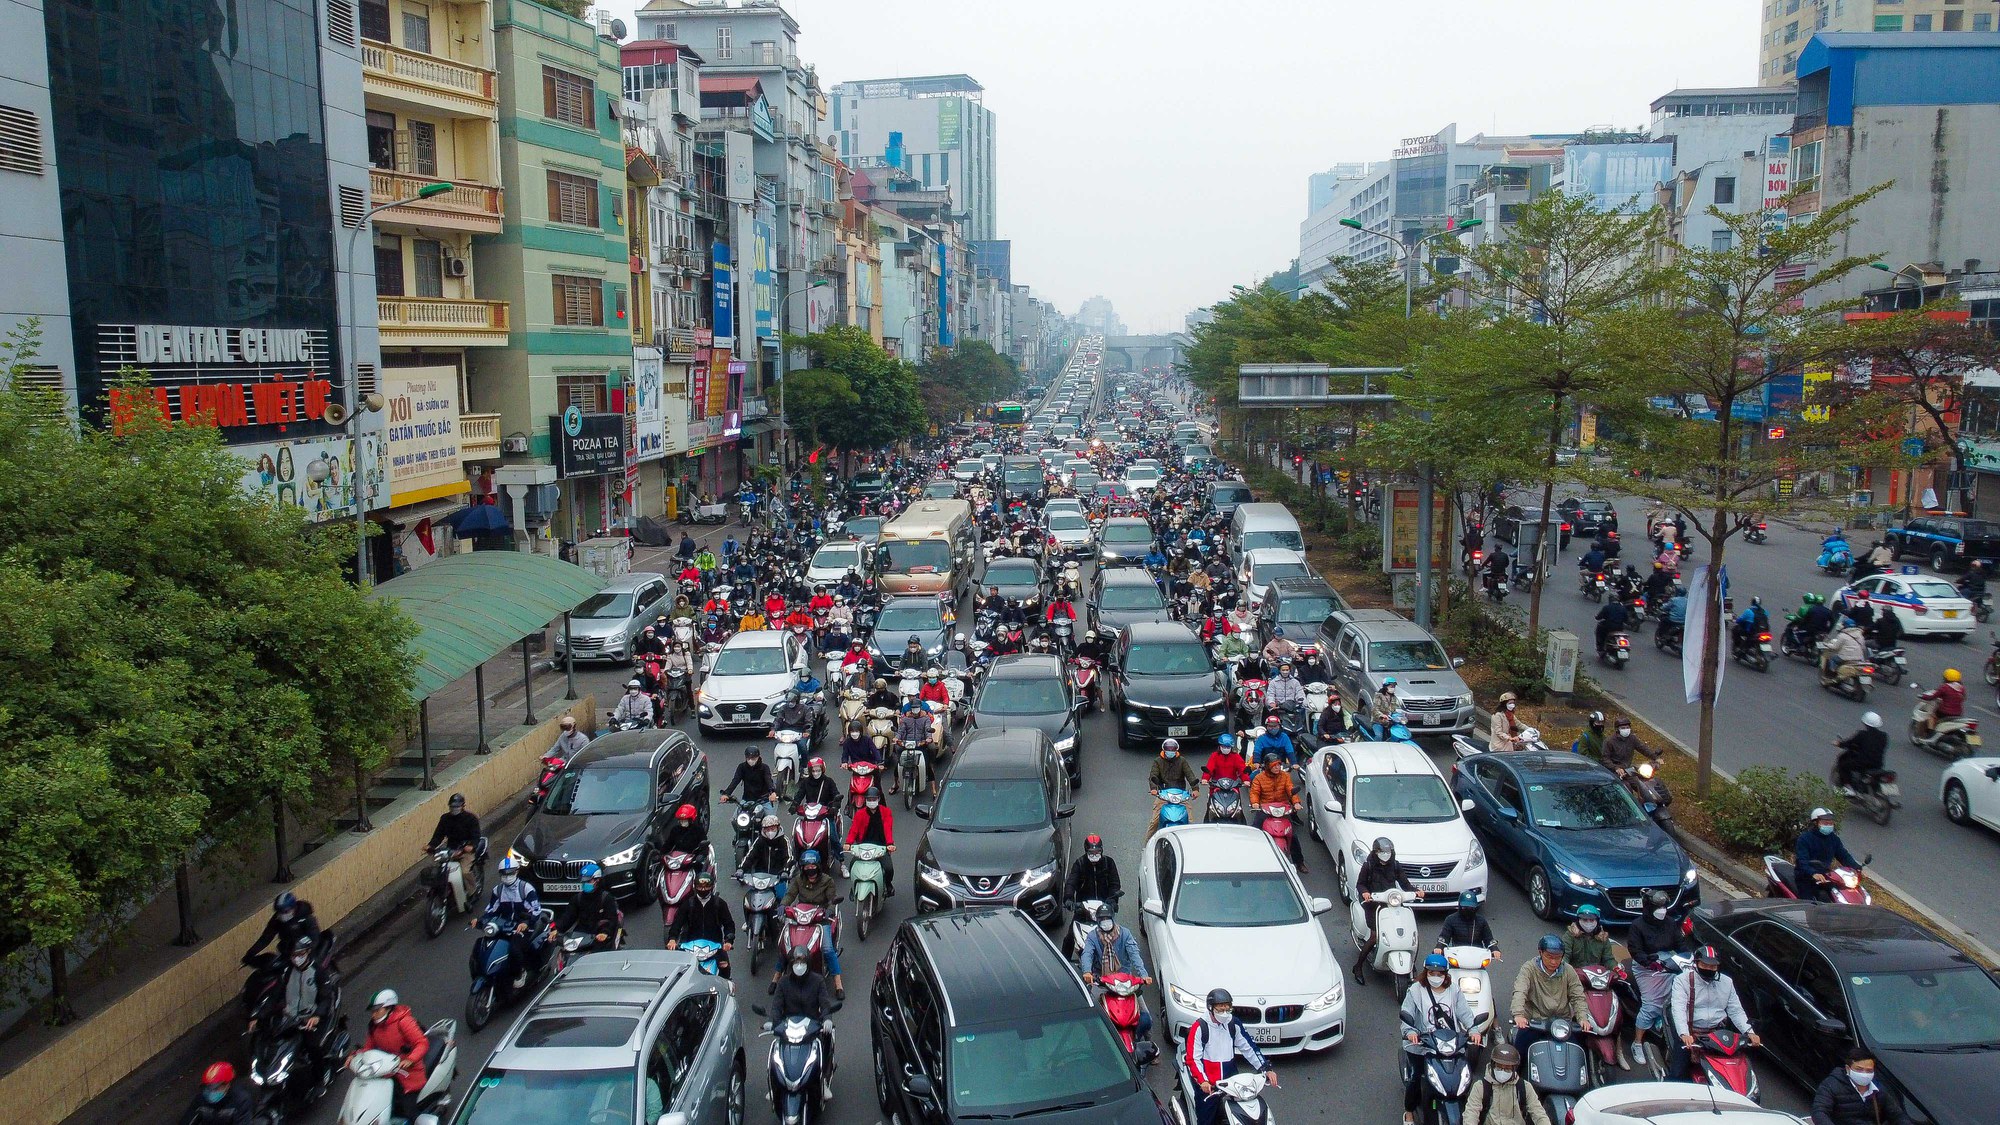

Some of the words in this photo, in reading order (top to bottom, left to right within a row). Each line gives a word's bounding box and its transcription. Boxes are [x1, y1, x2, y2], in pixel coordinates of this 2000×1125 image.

[1401, 136, 1439, 146] TOYOTA
[1768, 160, 1788, 175] MÁY
[135, 325, 234, 363] DENTAL
[240, 327, 309, 363] CLINIC
[109, 386, 172, 436] NA
[179, 382, 248, 428] KHOA
[252, 372, 298, 432] VIỆT
[303, 371, 331, 420] ÚC
[388, 394, 412, 422] XÔI
[414, 420, 437, 438] THUỐC
[438, 417, 451, 434] BẮC
[572, 438, 602, 451] POZAA
[604, 436, 619, 448] TEA
[428, 450, 439, 460] THEO
